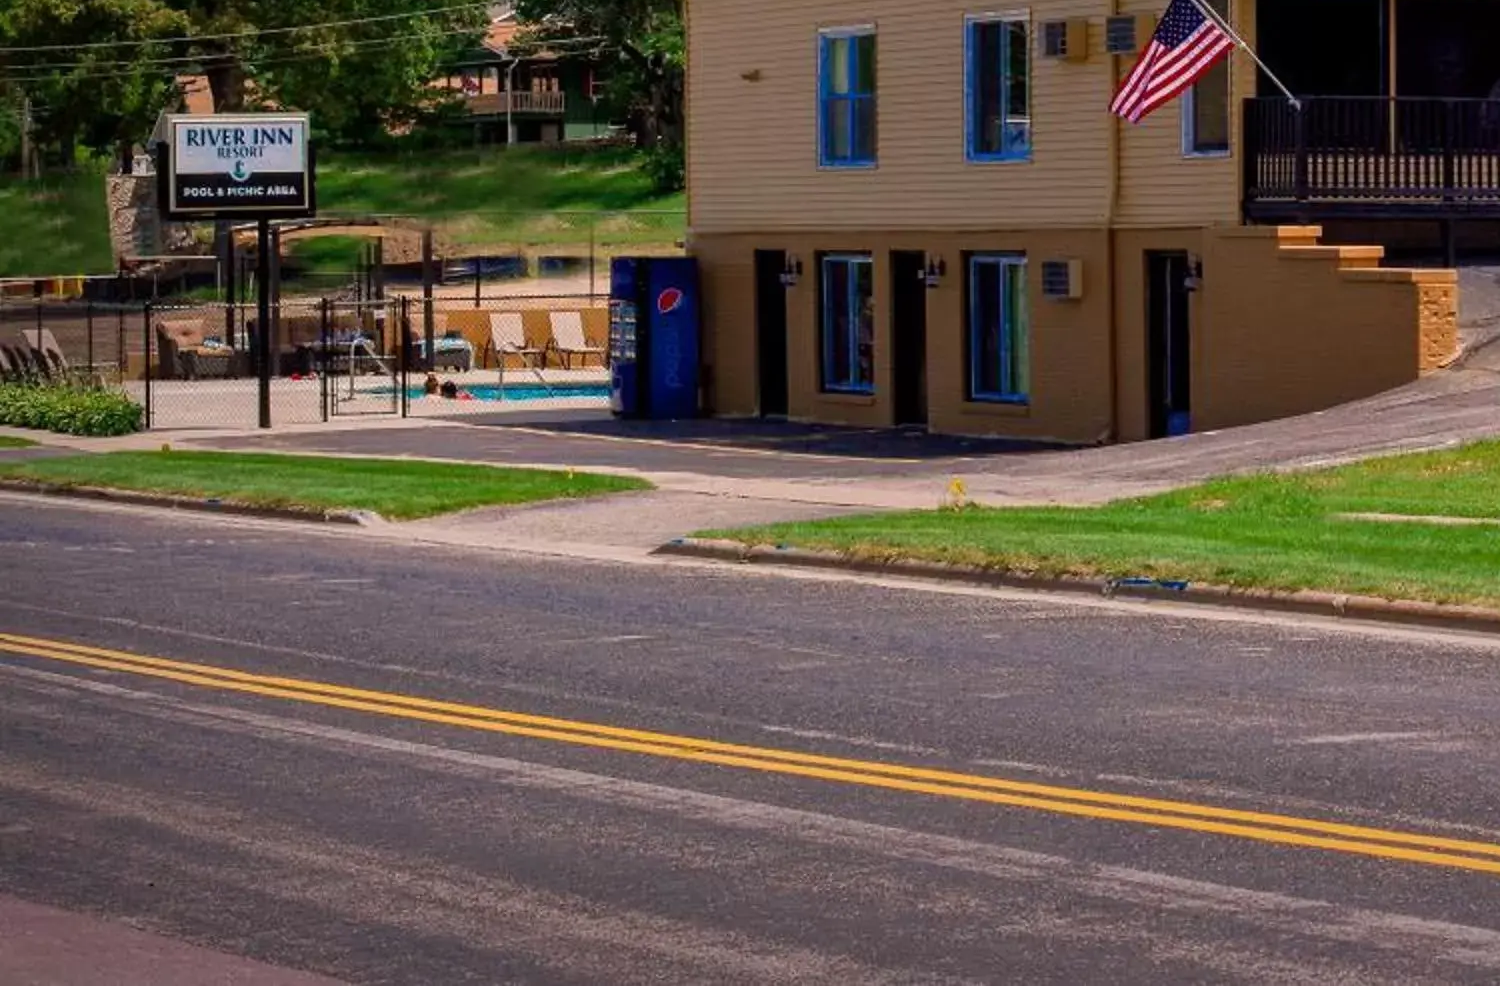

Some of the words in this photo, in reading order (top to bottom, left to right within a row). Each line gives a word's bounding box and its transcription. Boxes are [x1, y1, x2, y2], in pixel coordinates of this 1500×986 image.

[186, 128, 245, 147] RIVER
[251, 127, 294, 145] INN
[217, 146, 264, 159] RESORT
[183, 187, 214, 197] POOL
[217, 187, 225, 197] &
[267, 185, 297, 196] AREA
